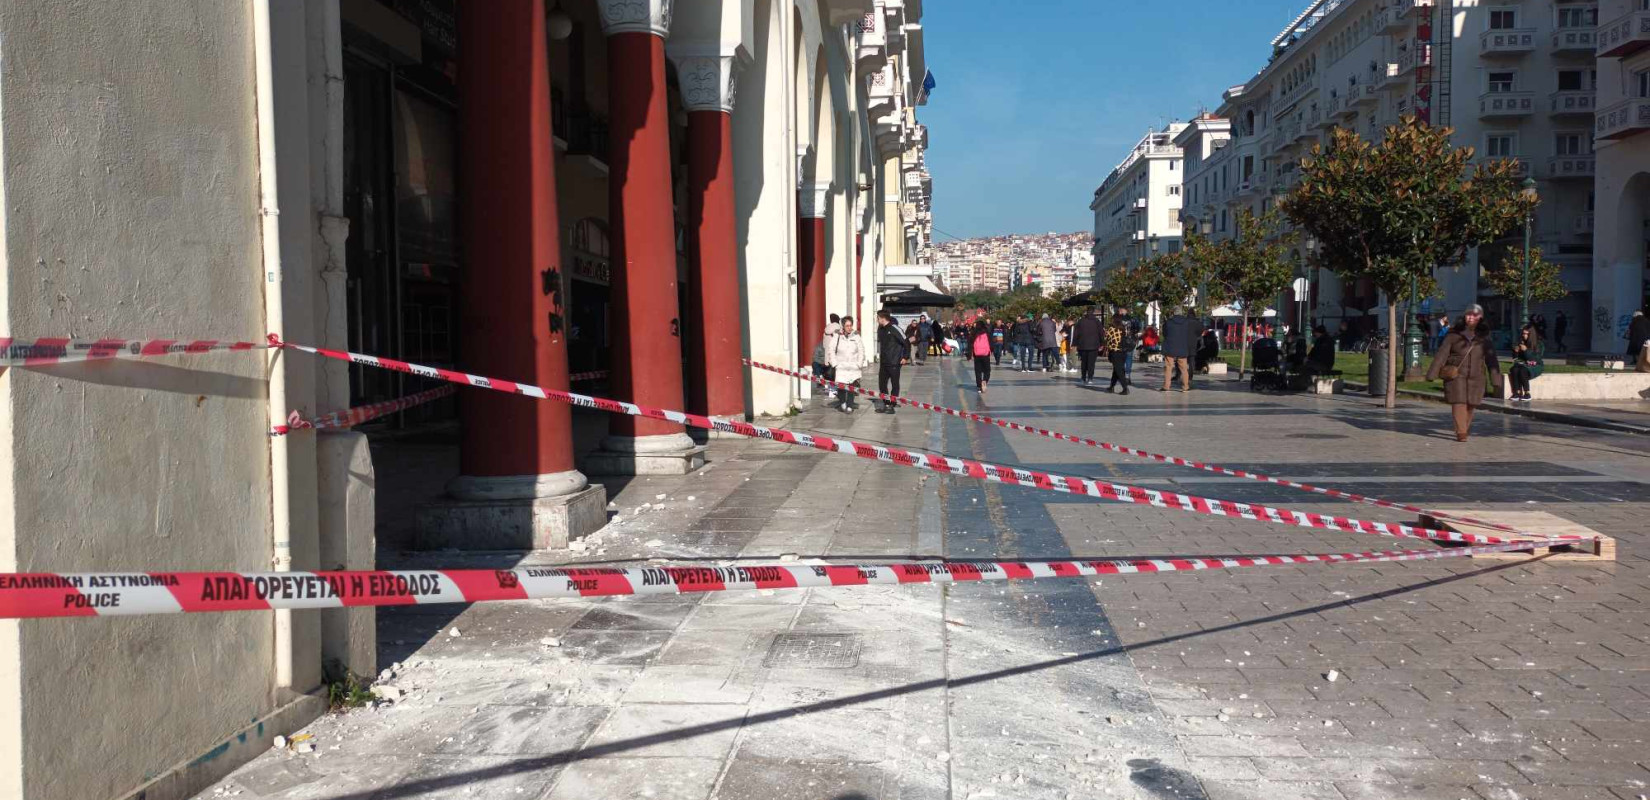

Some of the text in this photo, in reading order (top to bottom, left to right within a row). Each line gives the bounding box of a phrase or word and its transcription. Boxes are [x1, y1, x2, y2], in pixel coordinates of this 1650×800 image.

[0, 574, 179, 589] ΕΛΛΗΝΙΚΗ ΑΣΤΥΝΟΜΙΑ
[642, 565, 782, 586] ΑΠΑΓΟΡΕΥΕΤΑΙ Η ΕΙΣΟΔΟΣ
[201, 573, 441, 601] ΑΠΑΓΟΡΕΥΕΤΑΙ Η ΕΙΣΟΔΟΣ
[567, 579, 598, 591] POLICE
[64, 592, 120, 608] POLICE
